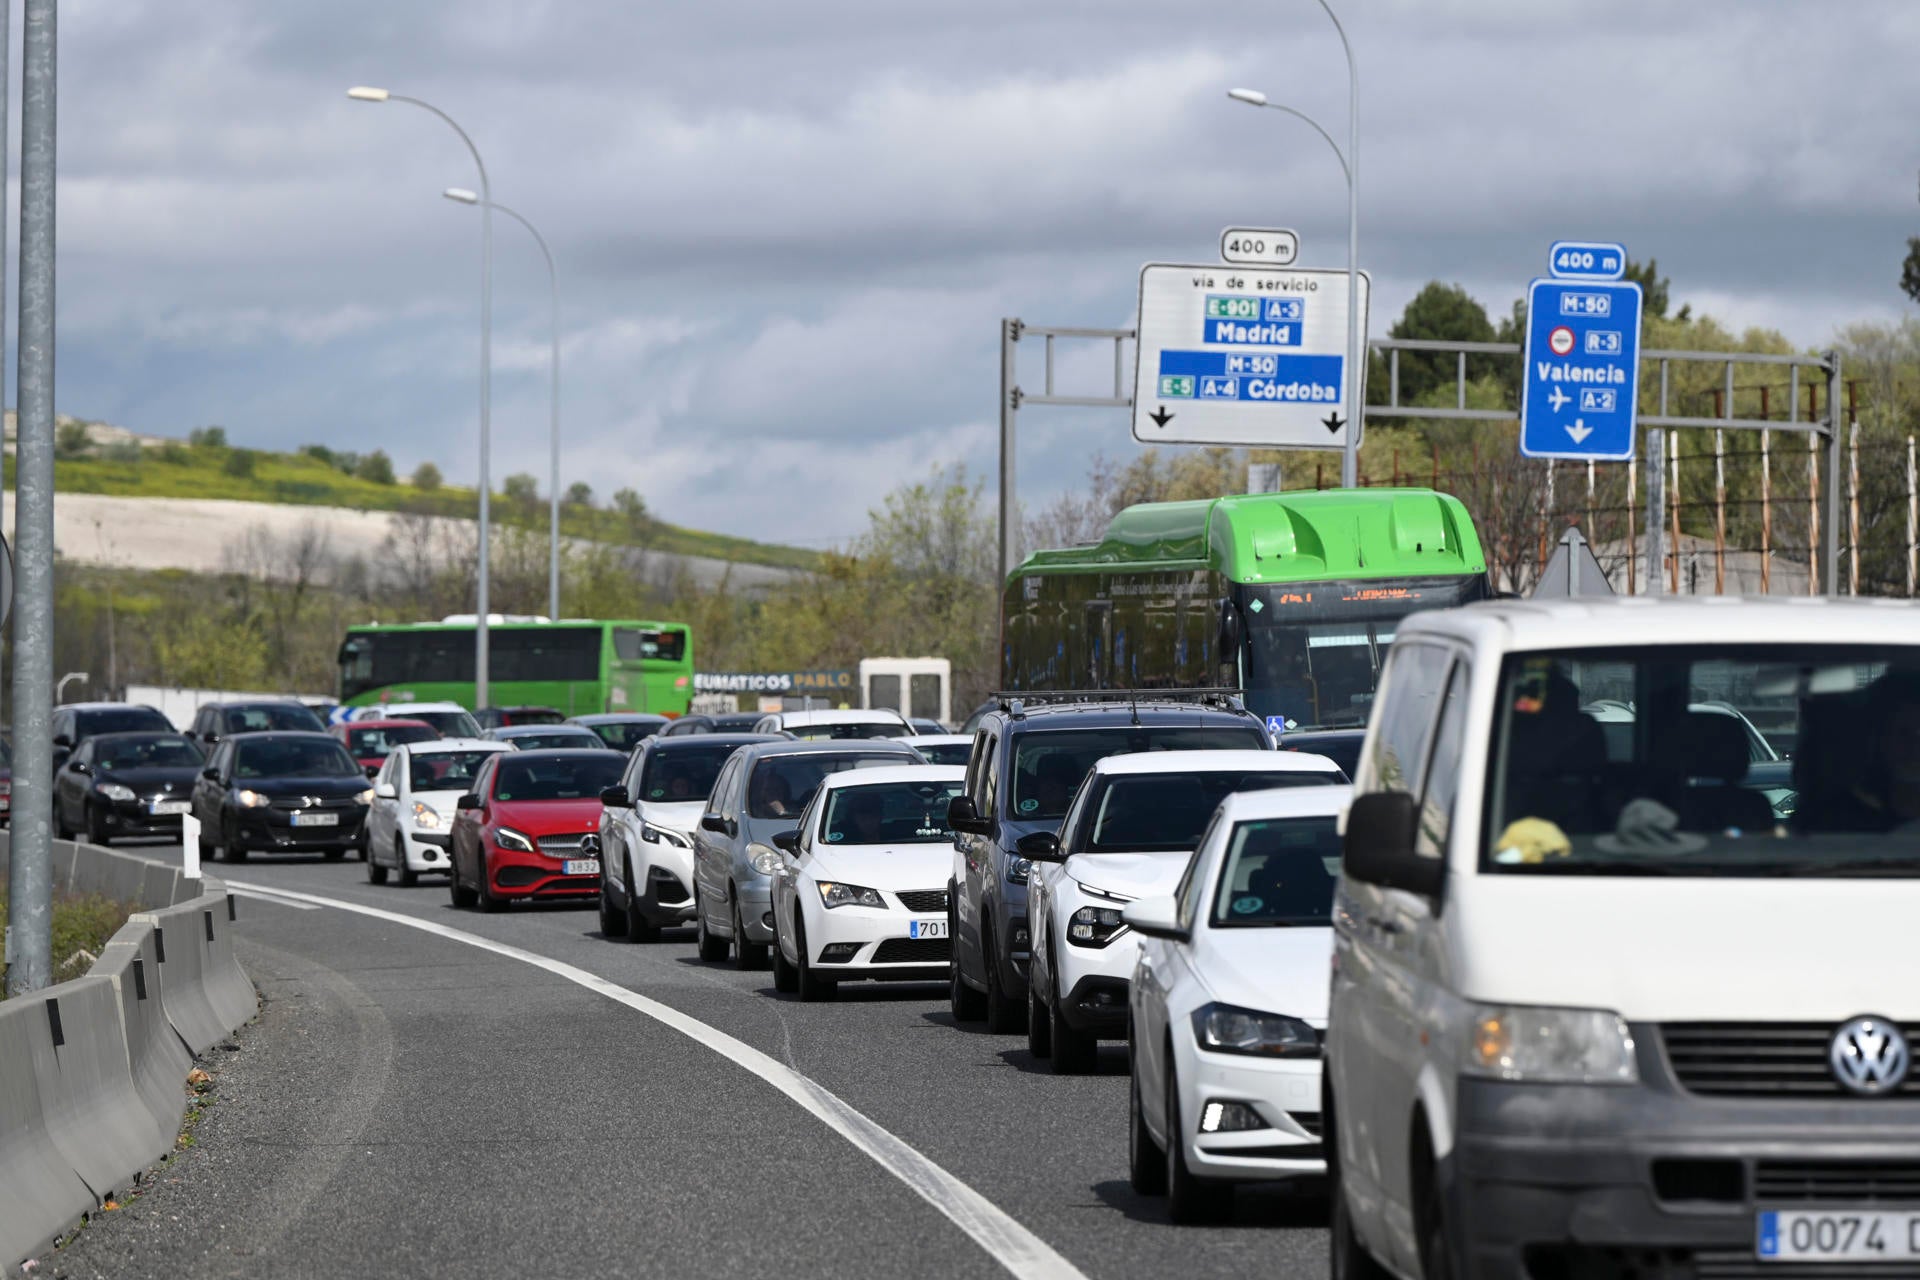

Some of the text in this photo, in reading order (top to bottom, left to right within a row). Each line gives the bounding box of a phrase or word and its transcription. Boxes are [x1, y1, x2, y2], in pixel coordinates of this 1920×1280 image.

[1229, 240, 1289, 255] 400 m
[1557, 253, 1617, 270] 400 m
[1227, 276, 1244, 288] de
[1257, 277, 1318, 292] servicio
[1209, 299, 1300, 318] E-901 A-3
[1563, 297, 1608, 313] M-50
[1216, 322, 1289, 343] Madrid
[1588, 335, 1617, 351] R-3
[1229, 357, 1273, 372] M-50
[1538, 362, 1625, 383] Valencia
[1162, 378, 1335, 400] E-5 A-4 Córdoba
[1584, 393, 1612, 407] A-2
[694, 673, 850, 690] EUMATICOS PABLO
[570, 862, 596, 872] 3832
[920, 922, 946, 936] 701
[1791, 1217, 1886, 1252] 0074
